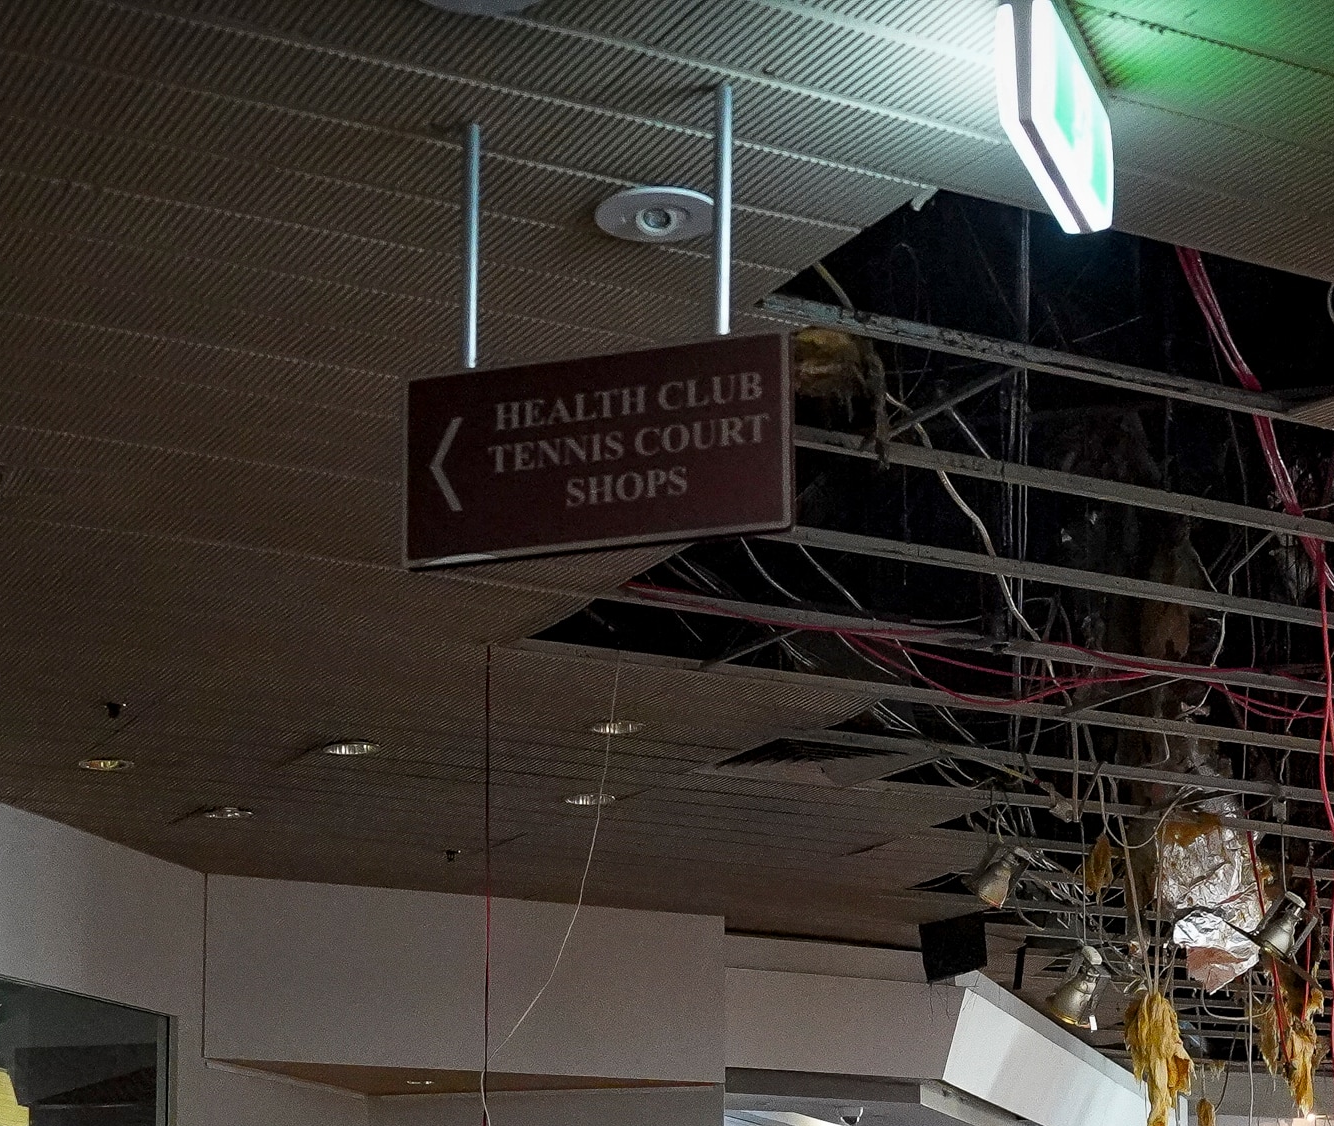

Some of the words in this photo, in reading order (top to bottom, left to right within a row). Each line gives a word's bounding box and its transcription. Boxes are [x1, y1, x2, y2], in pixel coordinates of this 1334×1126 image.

[495, 386, 647, 430] HEALTH
[658, 371, 764, 411] CLUB
[487, 432, 624, 474] TENNIS
[634, 413, 768, 456] COURT
[566, 466, 688, 508] SHOPS
